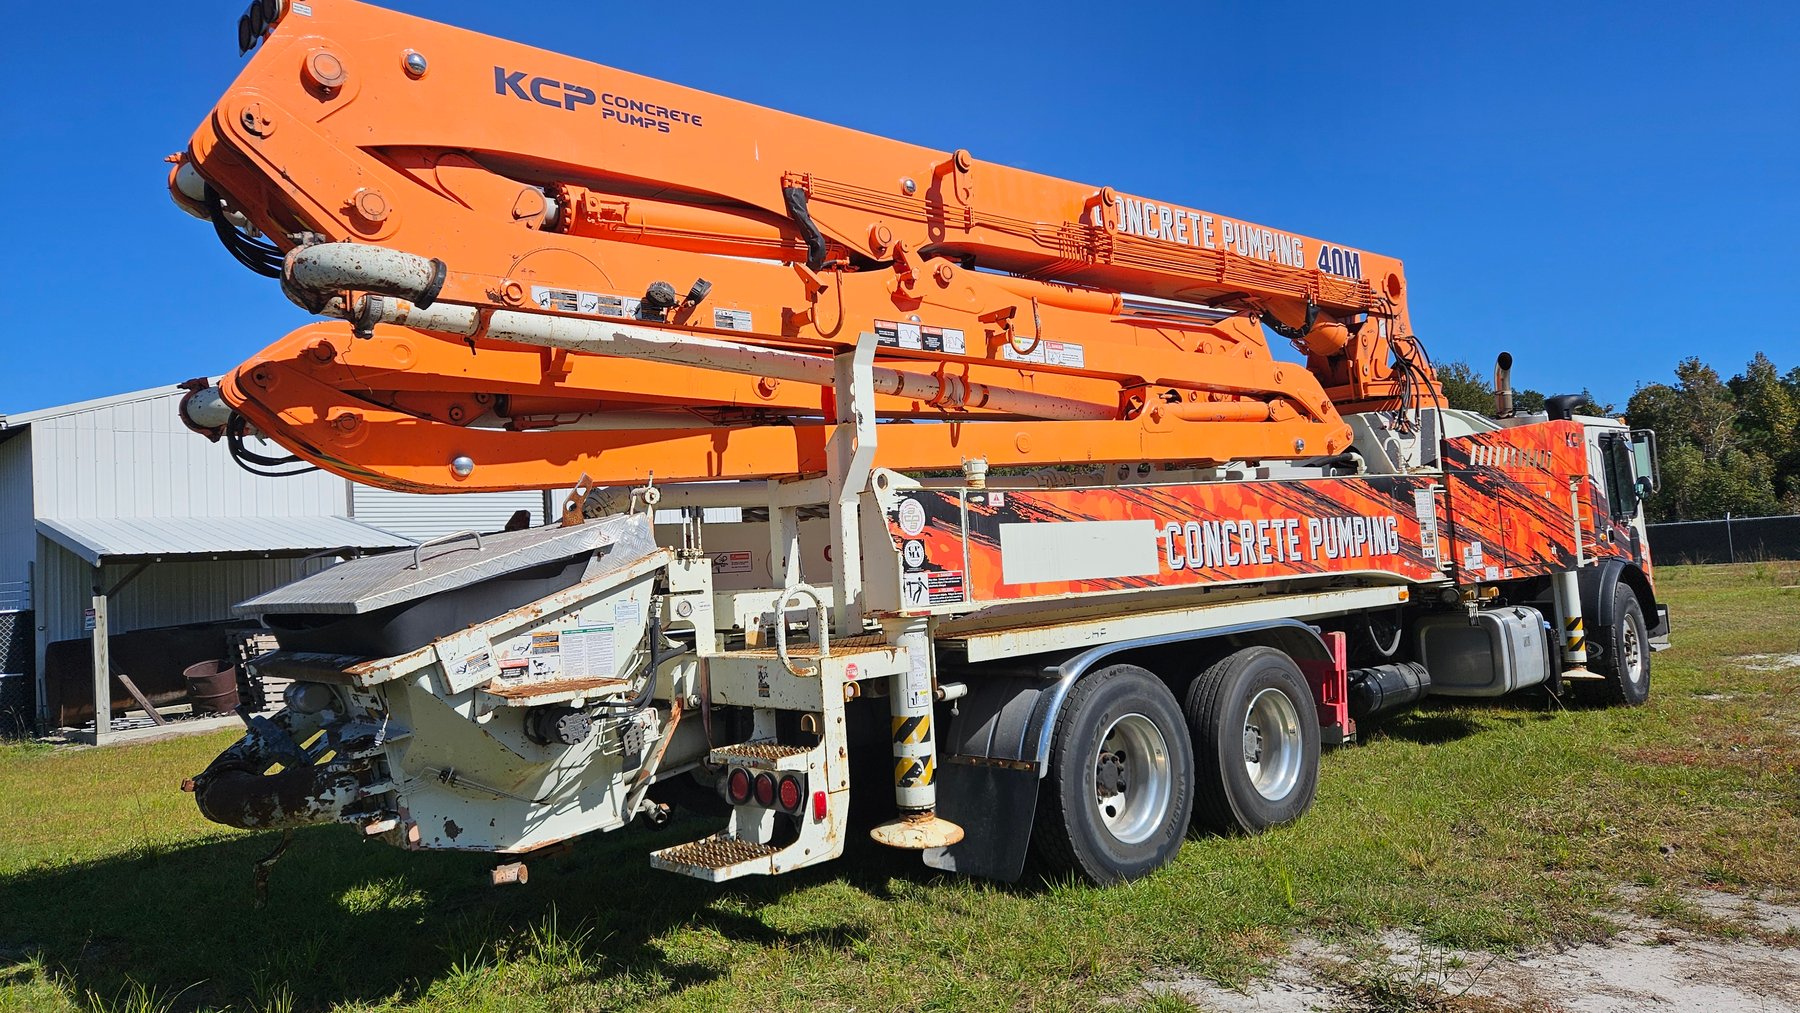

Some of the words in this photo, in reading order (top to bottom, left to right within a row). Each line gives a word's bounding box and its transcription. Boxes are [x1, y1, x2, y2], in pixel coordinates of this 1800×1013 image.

[494, 65, 597, 111] KCP
[601, 93, 703, 127] CONCRETE
[602, 107, 670, 133] PUMPS
[1222, 219, 1305, 269] PUMPING
[1316, 243, 1363, 280] 40M
[1165, 519, 1303, 571] CONCRETE
[1309, 515, 1400, 560] PUMPING
